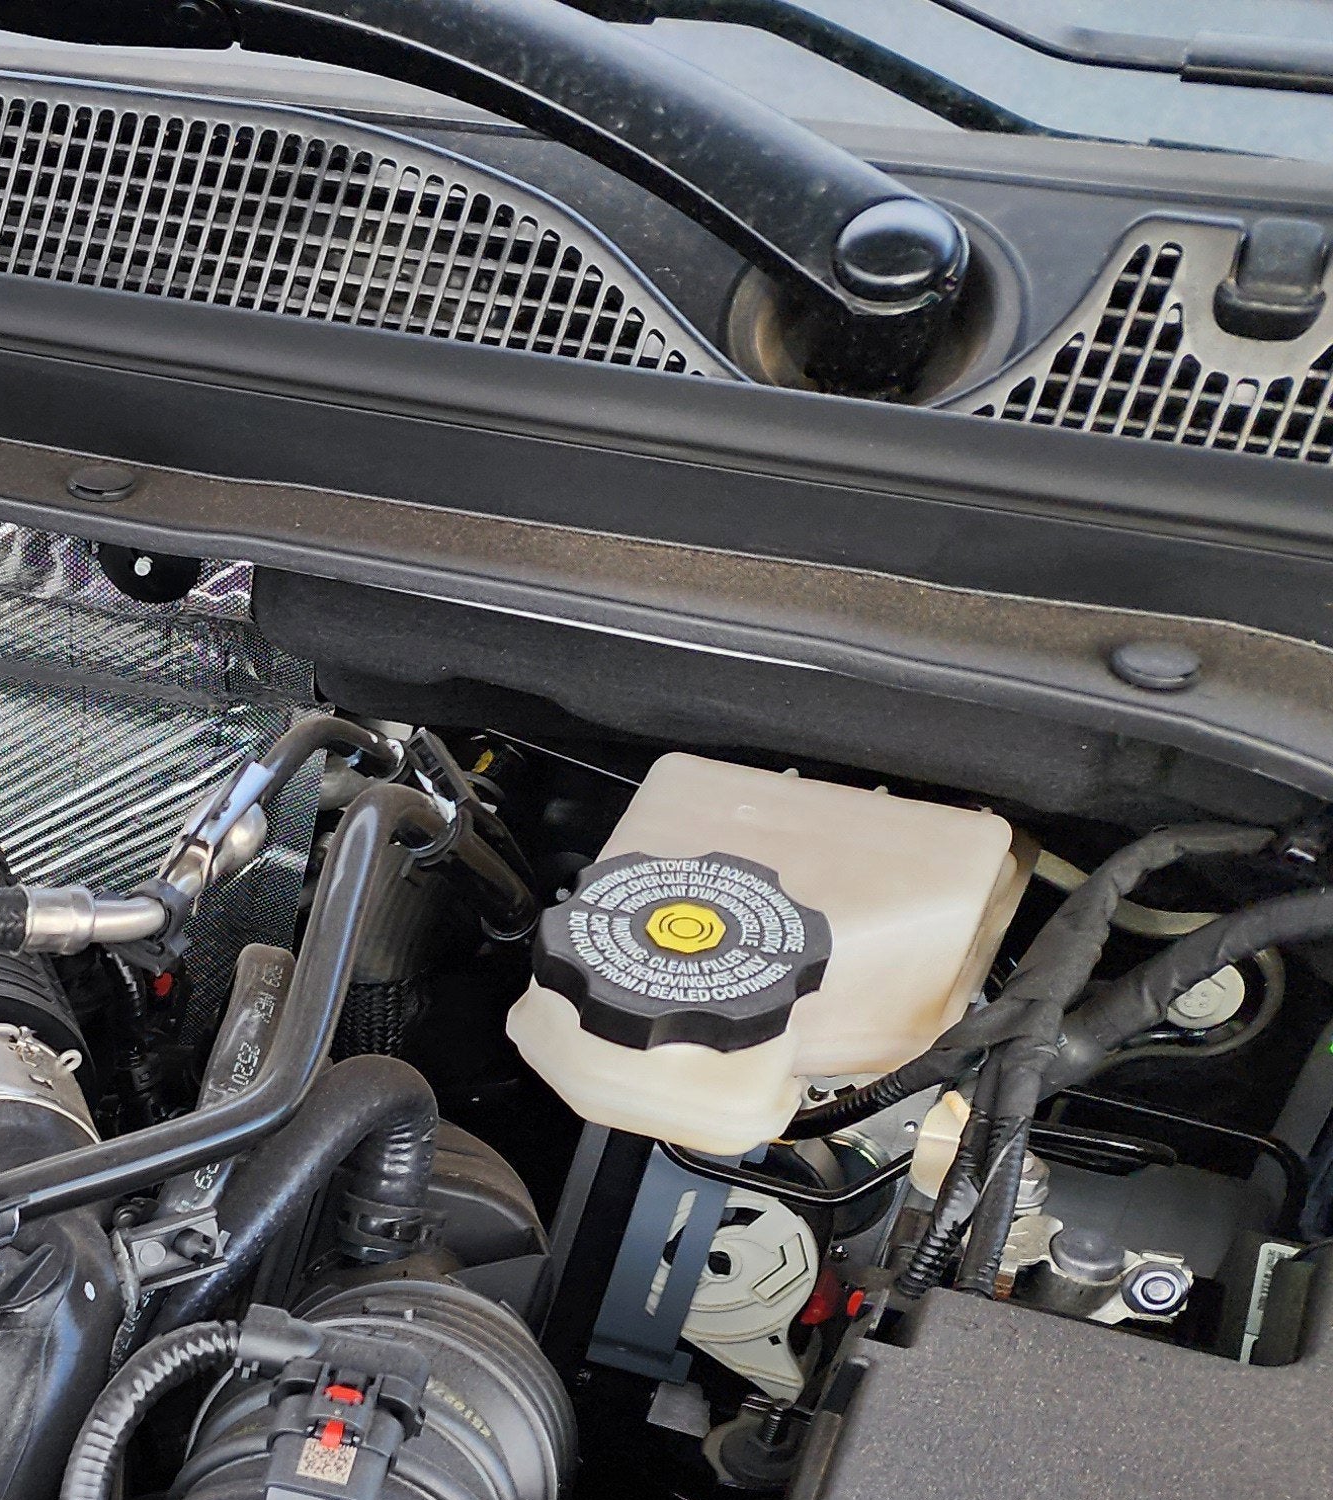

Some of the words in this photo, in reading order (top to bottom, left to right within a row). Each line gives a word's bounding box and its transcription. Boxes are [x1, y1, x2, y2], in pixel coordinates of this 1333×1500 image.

[633, 859, 700, 879] NETTOYER
[701, 860, 720, 876] LE
[660, 872, 690, 888] QUE
[689, 873, 708, 886] DU
[589, 912, 611, 934] CAP
[593, 933, 635, 971] BEFORE
[648, 955, 701, 976] CLEAN
[700, 947, 751, 975] FILLER
[572, 938, 605, 967] FLUID
[594, 961, 640, 991] FROM
[632, 980, 649, 996] A
[646, 982, 712, 1004] SEALED
[732, 954, 770, 980] ONLY
